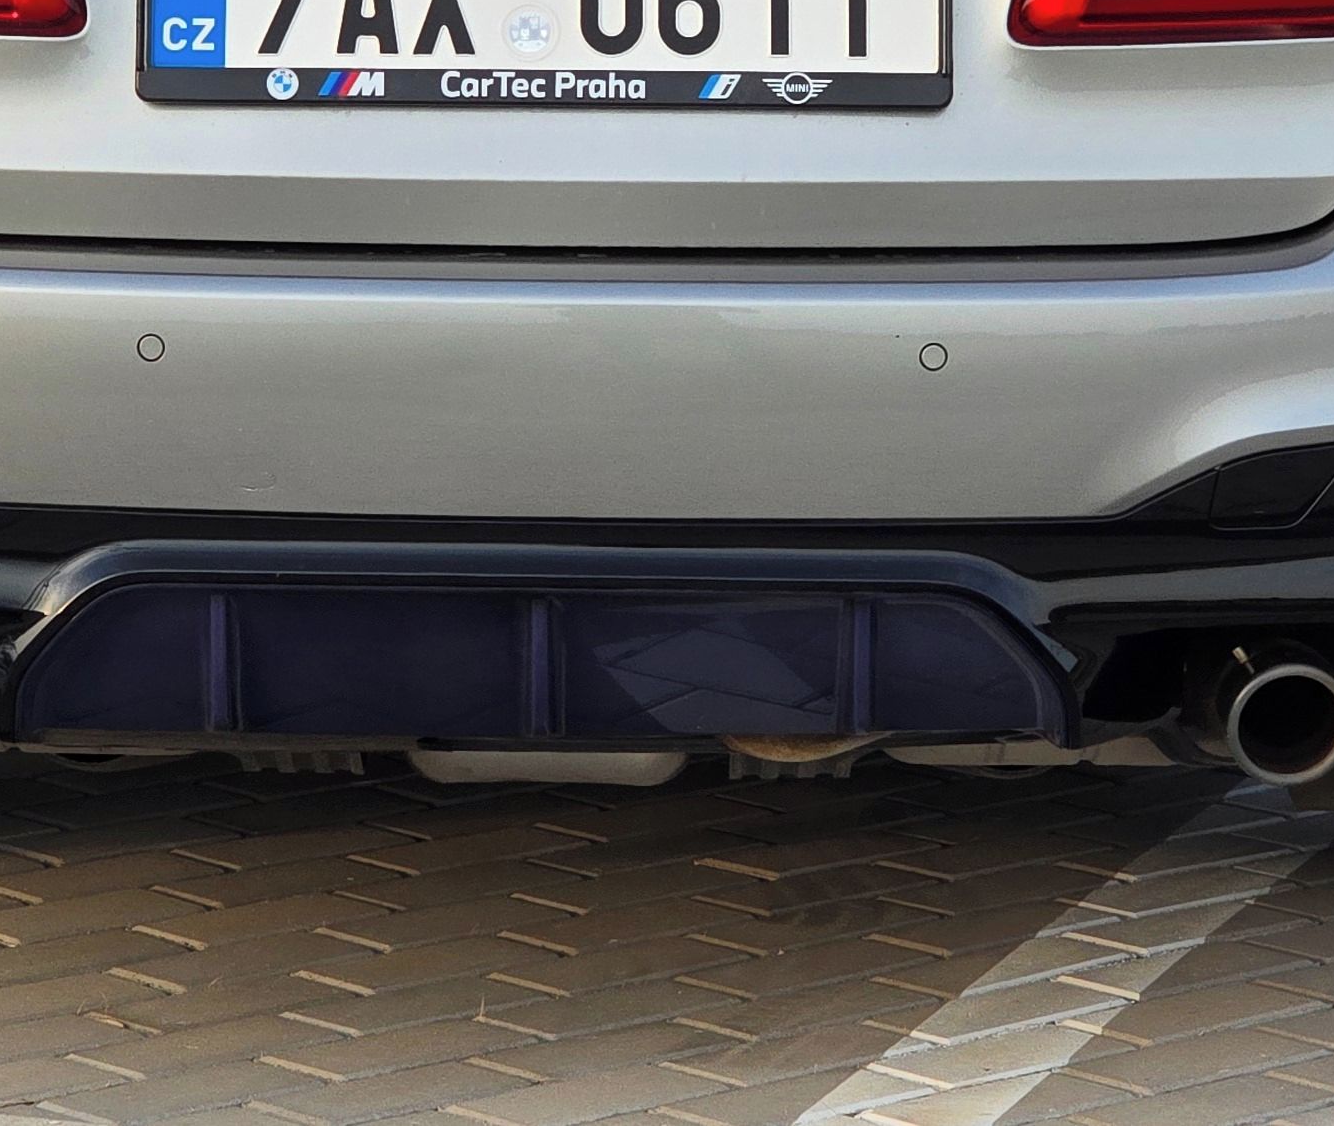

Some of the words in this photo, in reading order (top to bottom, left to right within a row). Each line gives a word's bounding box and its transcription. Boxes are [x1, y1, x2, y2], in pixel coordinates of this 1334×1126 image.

[162, 17, 215, 51] CZ
[440, 70, 546, 98] CarTec
[554, 71, 646, 99] Praha
[786, 83, 809, 93] MINI
